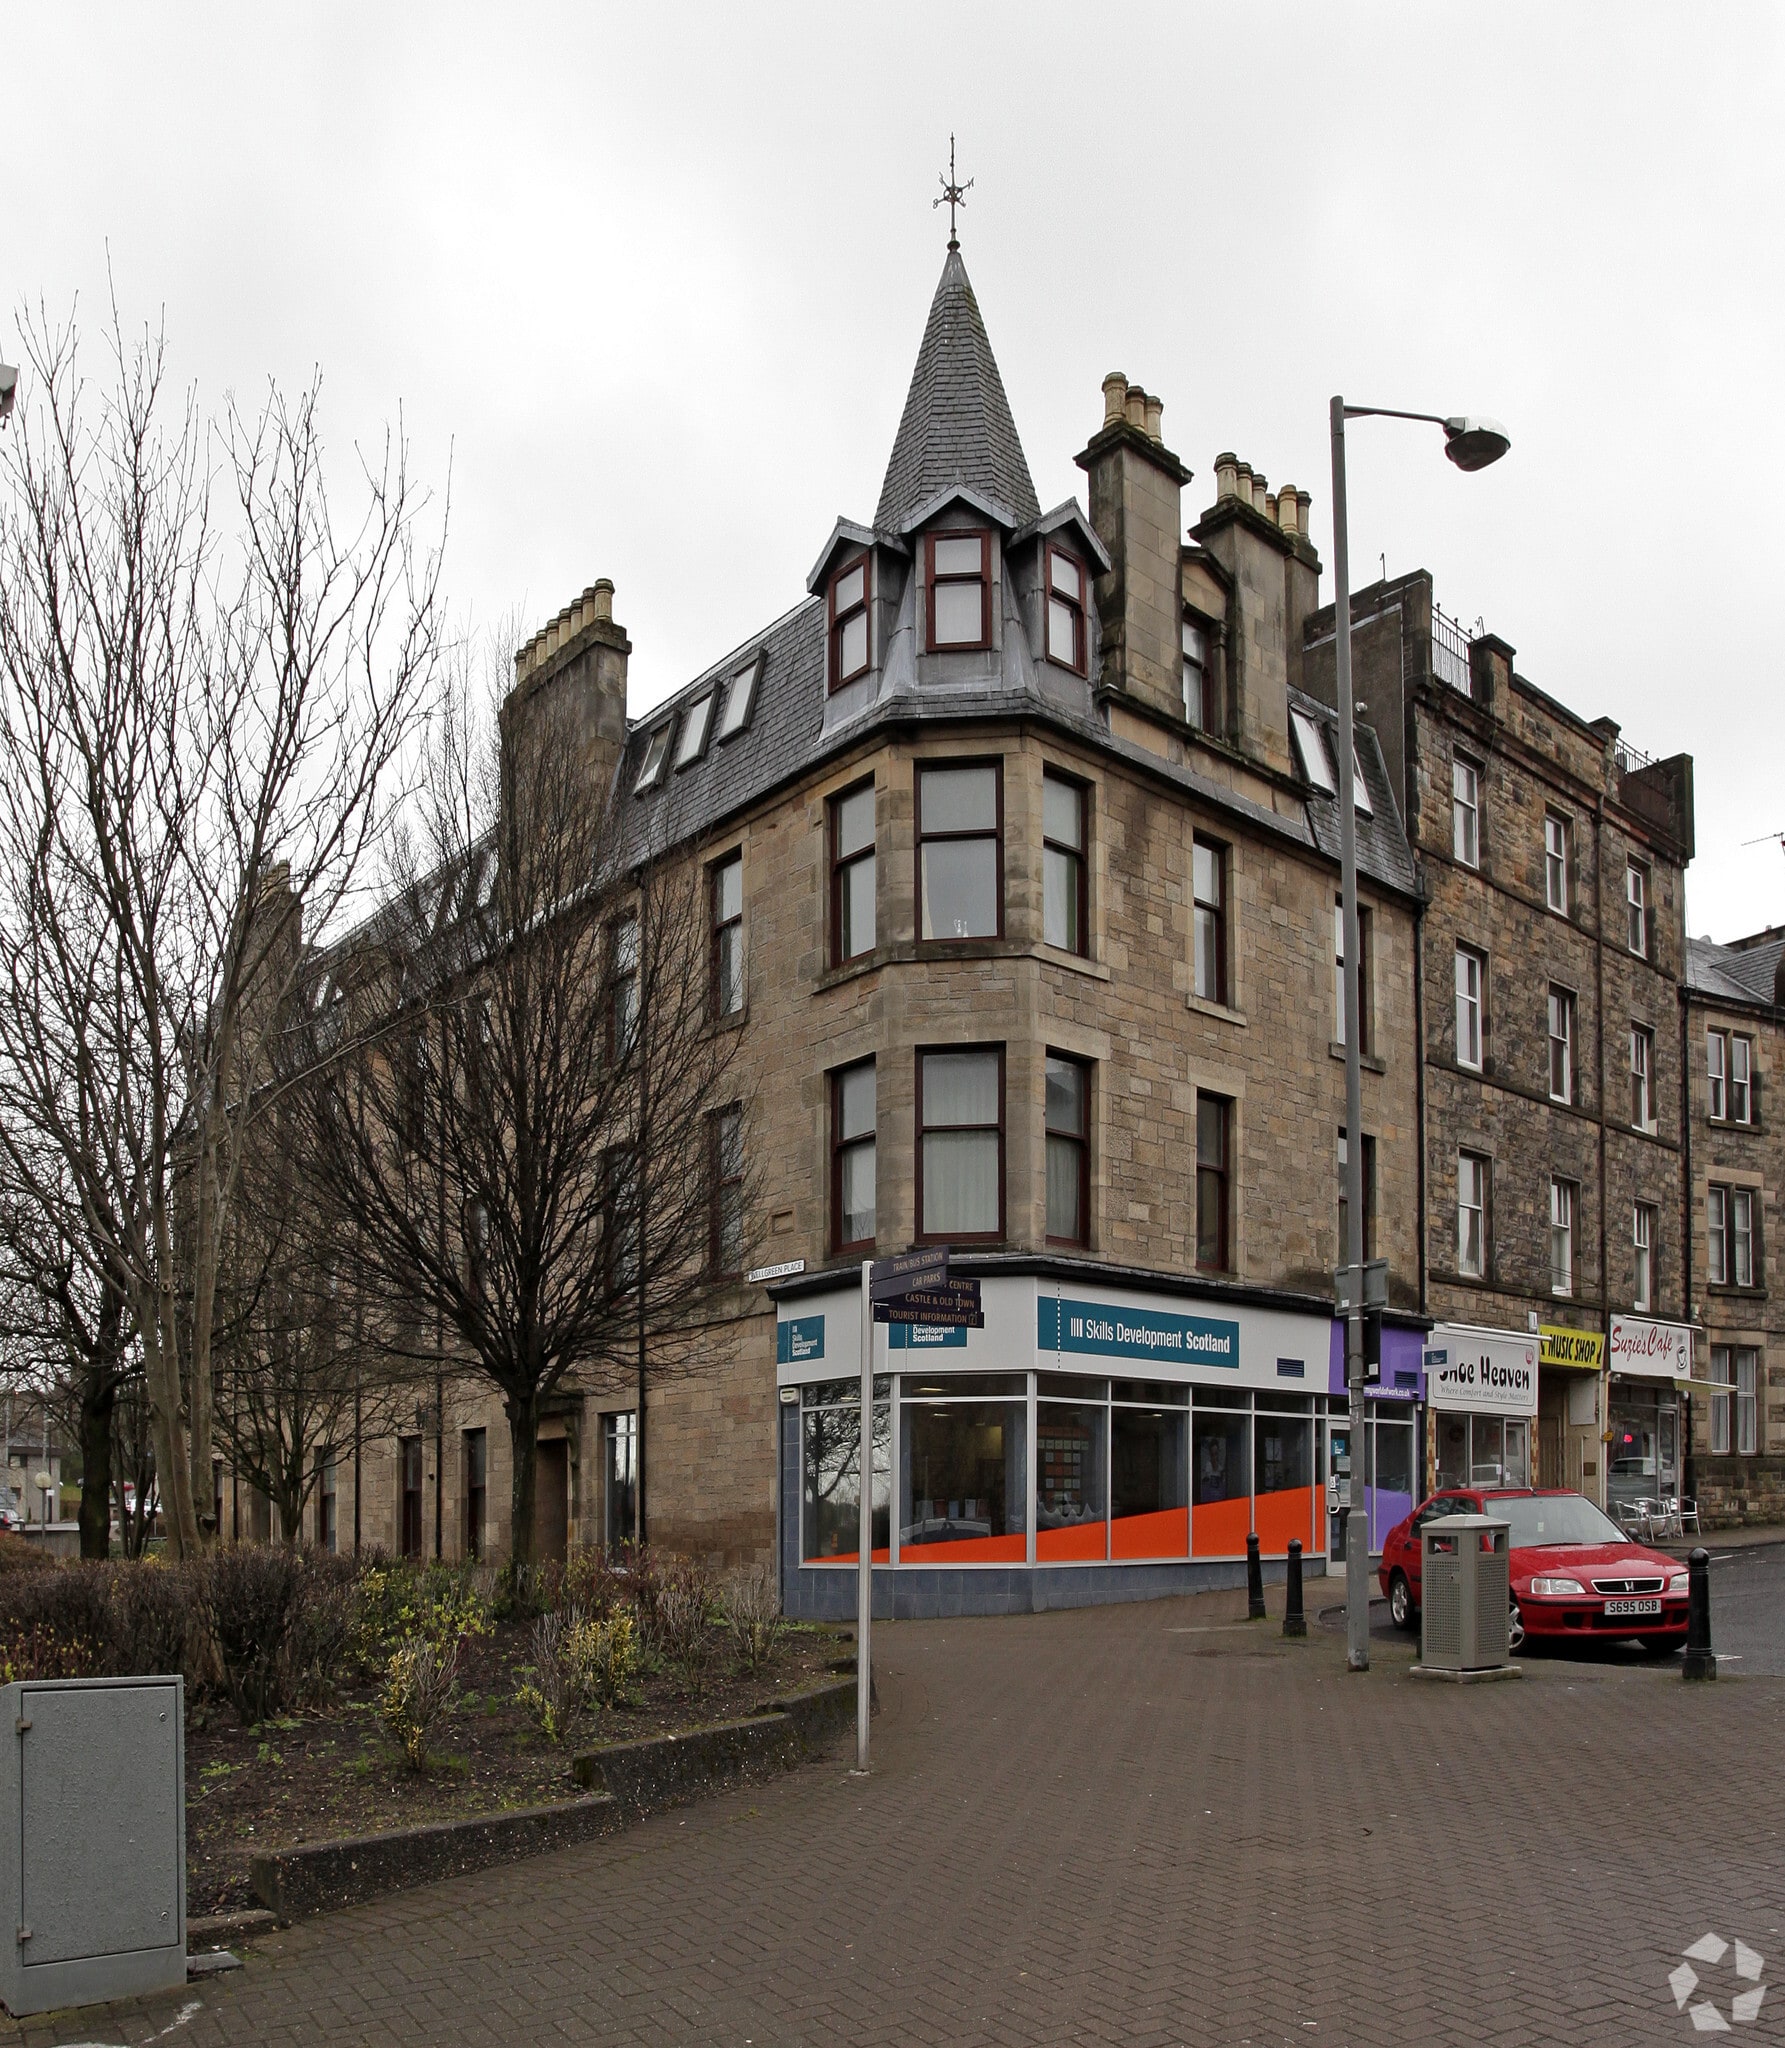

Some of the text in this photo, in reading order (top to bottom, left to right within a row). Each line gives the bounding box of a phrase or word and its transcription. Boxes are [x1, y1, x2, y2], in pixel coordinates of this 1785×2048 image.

[921, 1252, 943, 1264] STATION
[784, 1261, 802, 1273] PLACE
[912, 1272, 940, 1287] CAR PARKS
[949, 1280, 974, 1291] CENTRE
[905, 1293, 975, 1309] CASTLE & OLD TOWN
[889, 1310, 967, 1323] TOURIST INFORMATION
[913, 1326, 955, 1335] Development
[1086, 1319, 1230, 1353] Skills Development Scotland
[913, 1334, 944, 1342] Scotland
[1611, 1326, 1646, 1361] Suzie's
[1549, 1334, 1573, 1360] MUSIC
[1575, 1338, 1596, 1364] SHOP
[1480, 1355, 1530, 1390] Heaven
[1609, 1601, 1657, 1613] S695 OSB
